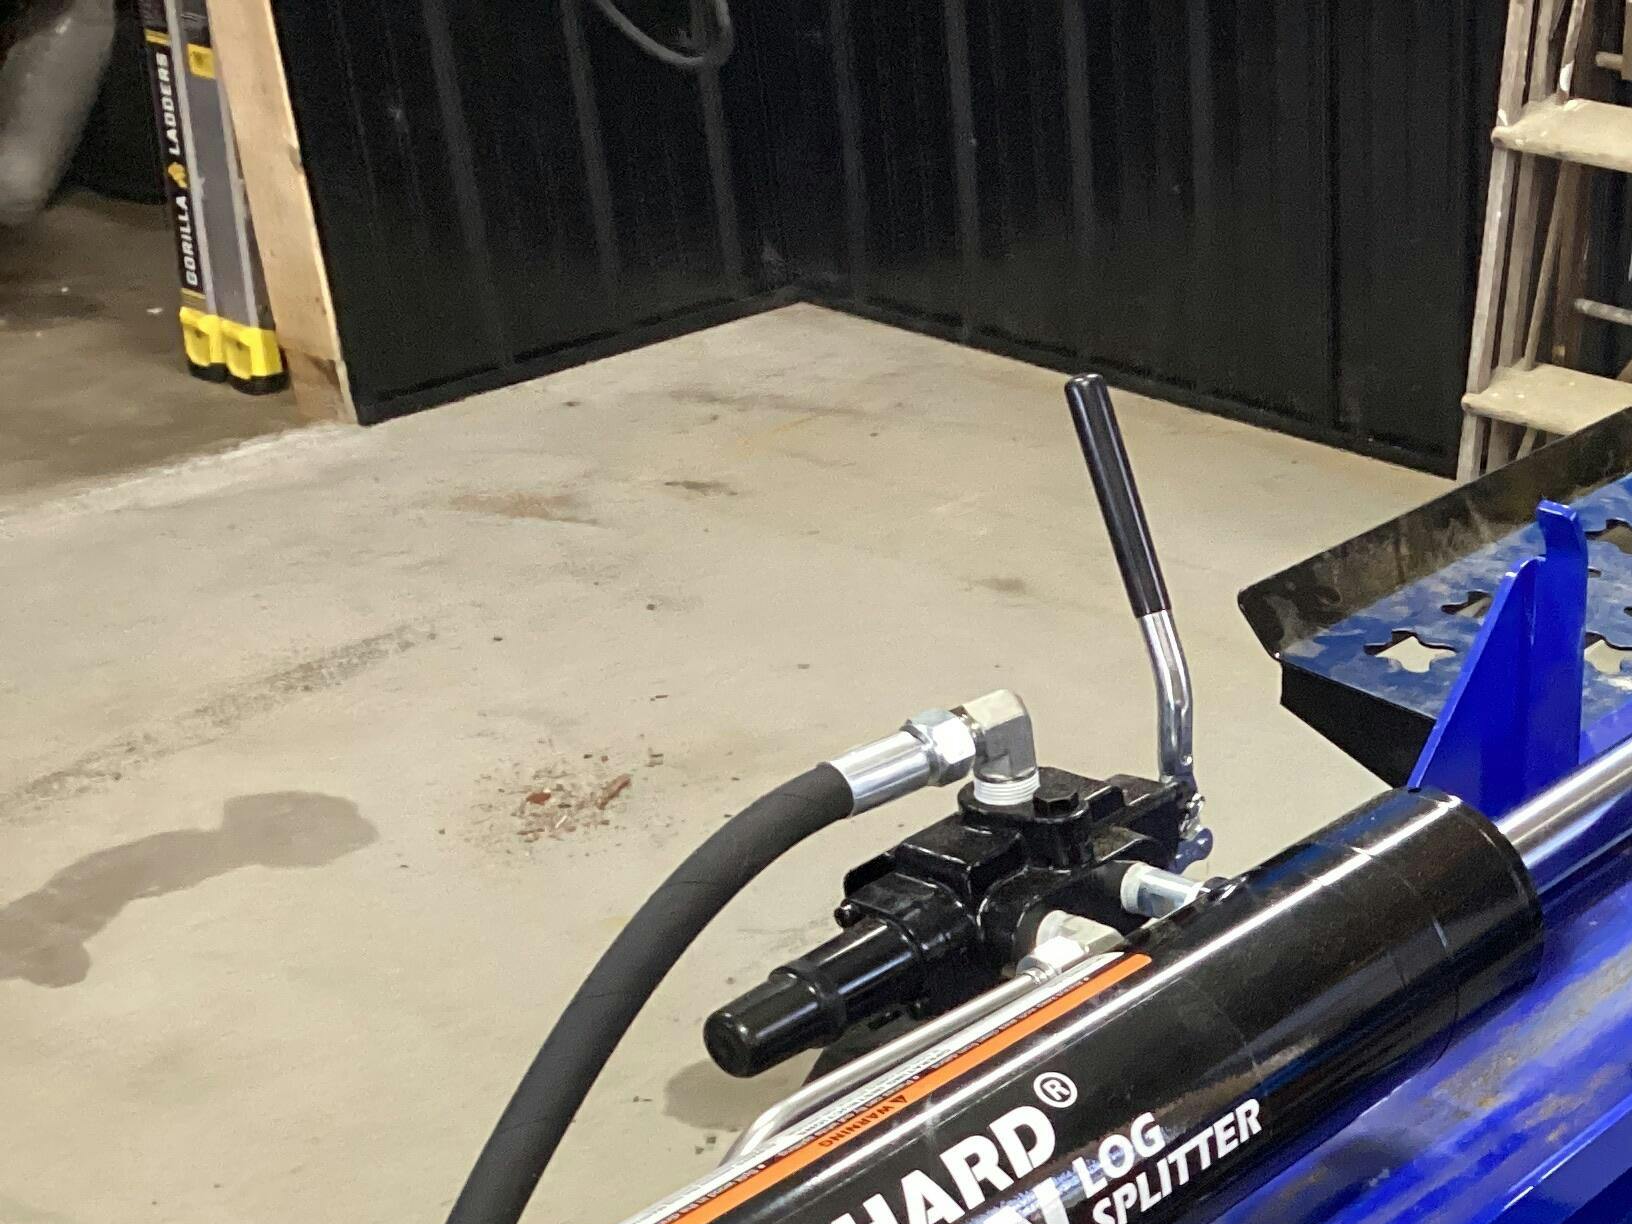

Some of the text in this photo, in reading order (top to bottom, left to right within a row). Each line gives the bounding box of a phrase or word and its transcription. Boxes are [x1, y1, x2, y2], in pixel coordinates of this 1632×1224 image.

[156, 53, 198, 286] GORILLA LADDERS
[818, 1104, 893, 1148] WARNING
[1072, 1112, 1166, 1200] LOG
